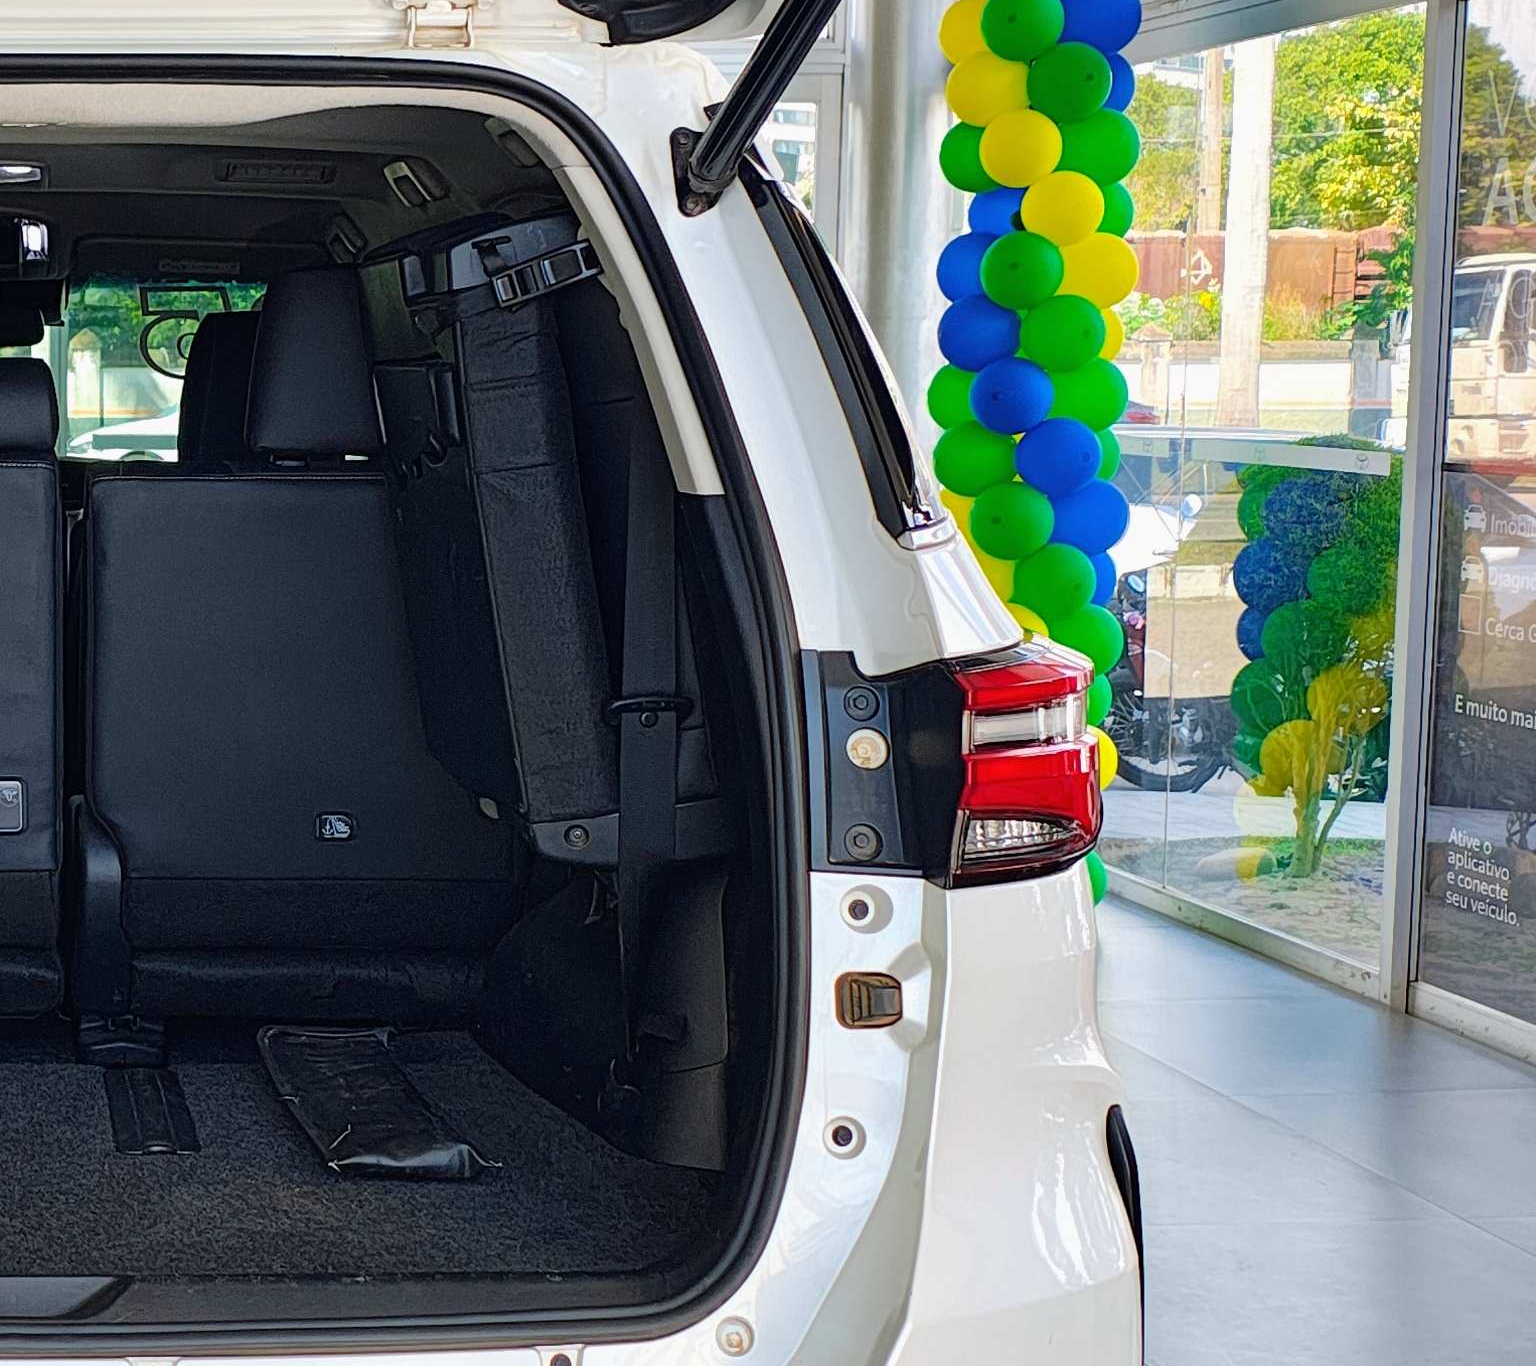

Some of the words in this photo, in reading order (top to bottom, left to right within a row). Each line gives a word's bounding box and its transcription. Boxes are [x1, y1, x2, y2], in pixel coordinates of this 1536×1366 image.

[1485, 617, 1524, 641] Cerca
[1454, 694, 1464, 713] E
[1466, 700, 1508, 723] muito
[1448, 827, 1481, 852] Ative
[1484, 841, 1492, 855] o
[1448, 850, 1510, 881] aplicativo
[1447, 871, 1455, 884] e
[1457, 874, 1509, 902] conecte
[1446, 890, 1468, 909] seu
[1470, 898, 1520, 927] veículo.
